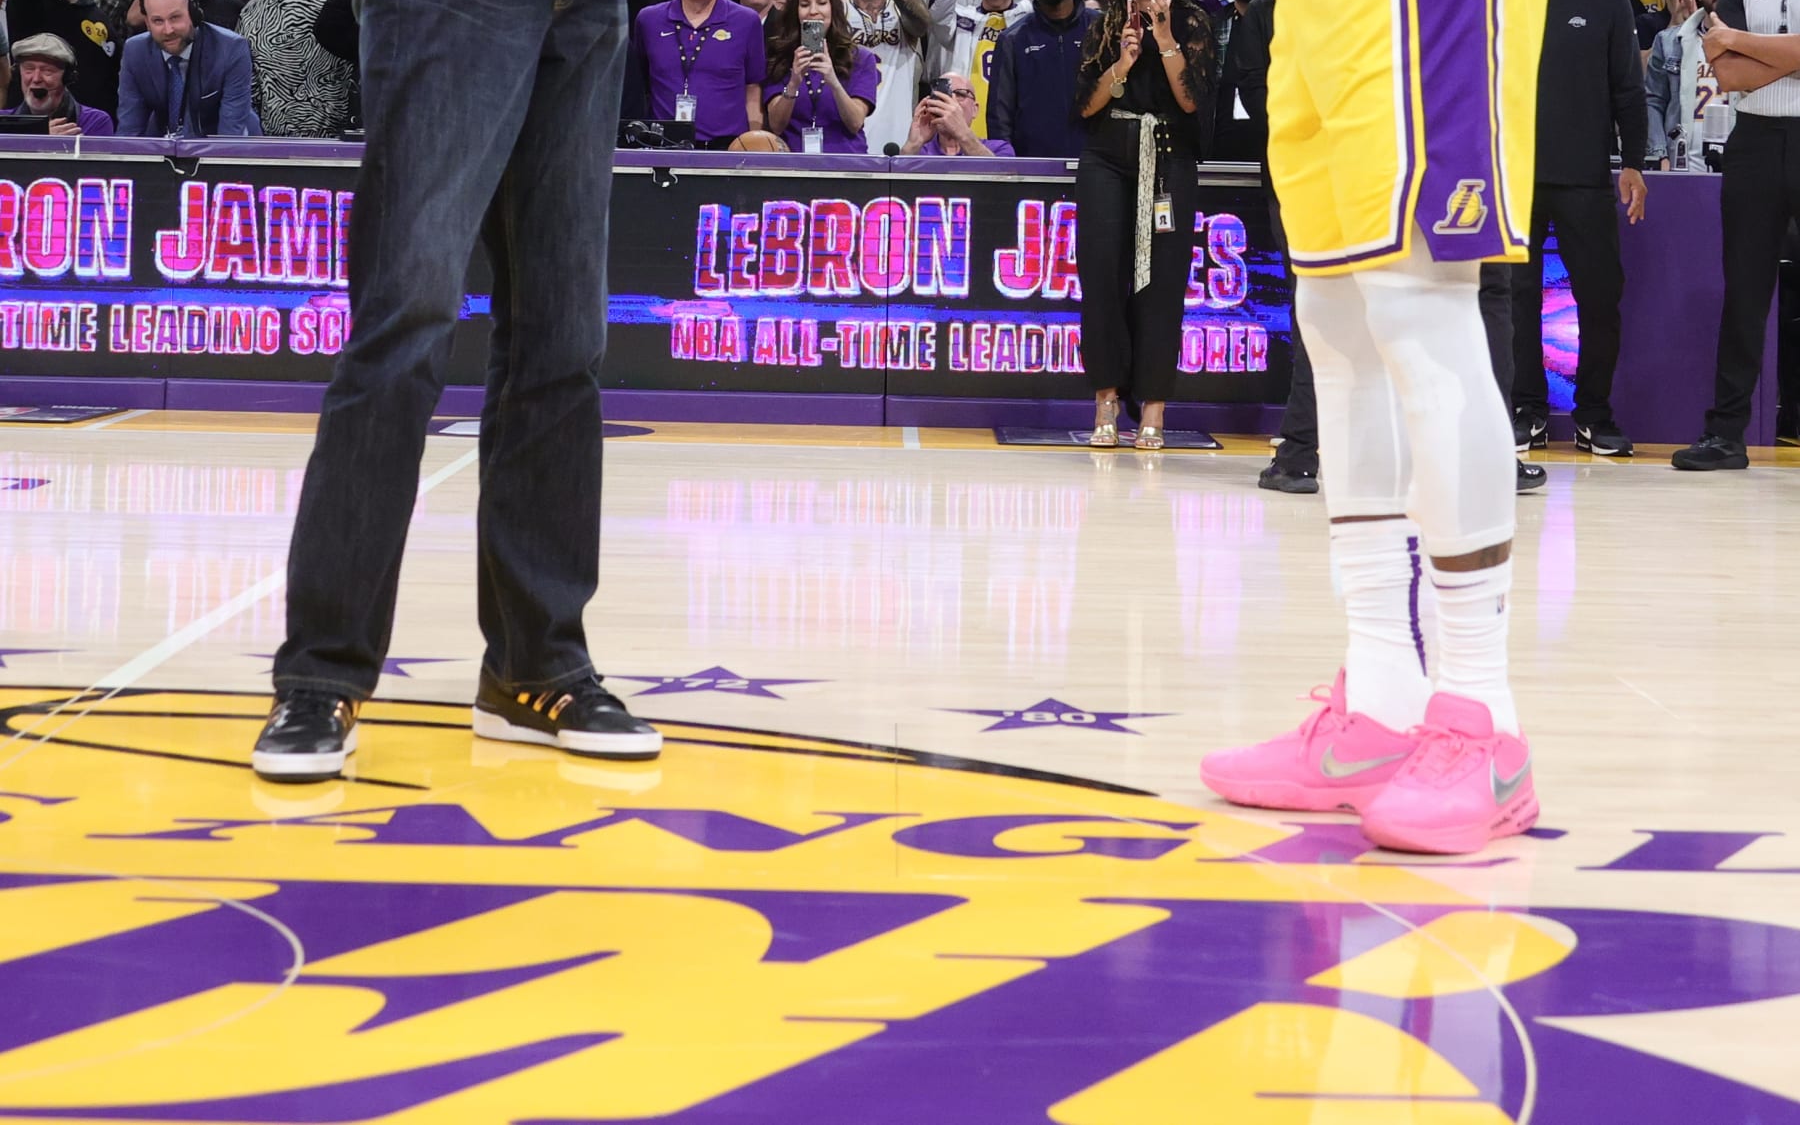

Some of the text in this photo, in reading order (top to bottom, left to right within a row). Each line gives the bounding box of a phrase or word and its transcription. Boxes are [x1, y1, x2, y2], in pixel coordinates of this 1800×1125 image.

[109, 304, 281, 354] LEADING
[670, 315, 1085, 374] NBA ALL-TIME LEADIN
[1177, 325, 1268, 373] ORER
[1002, 710, 1097, 724] '80
